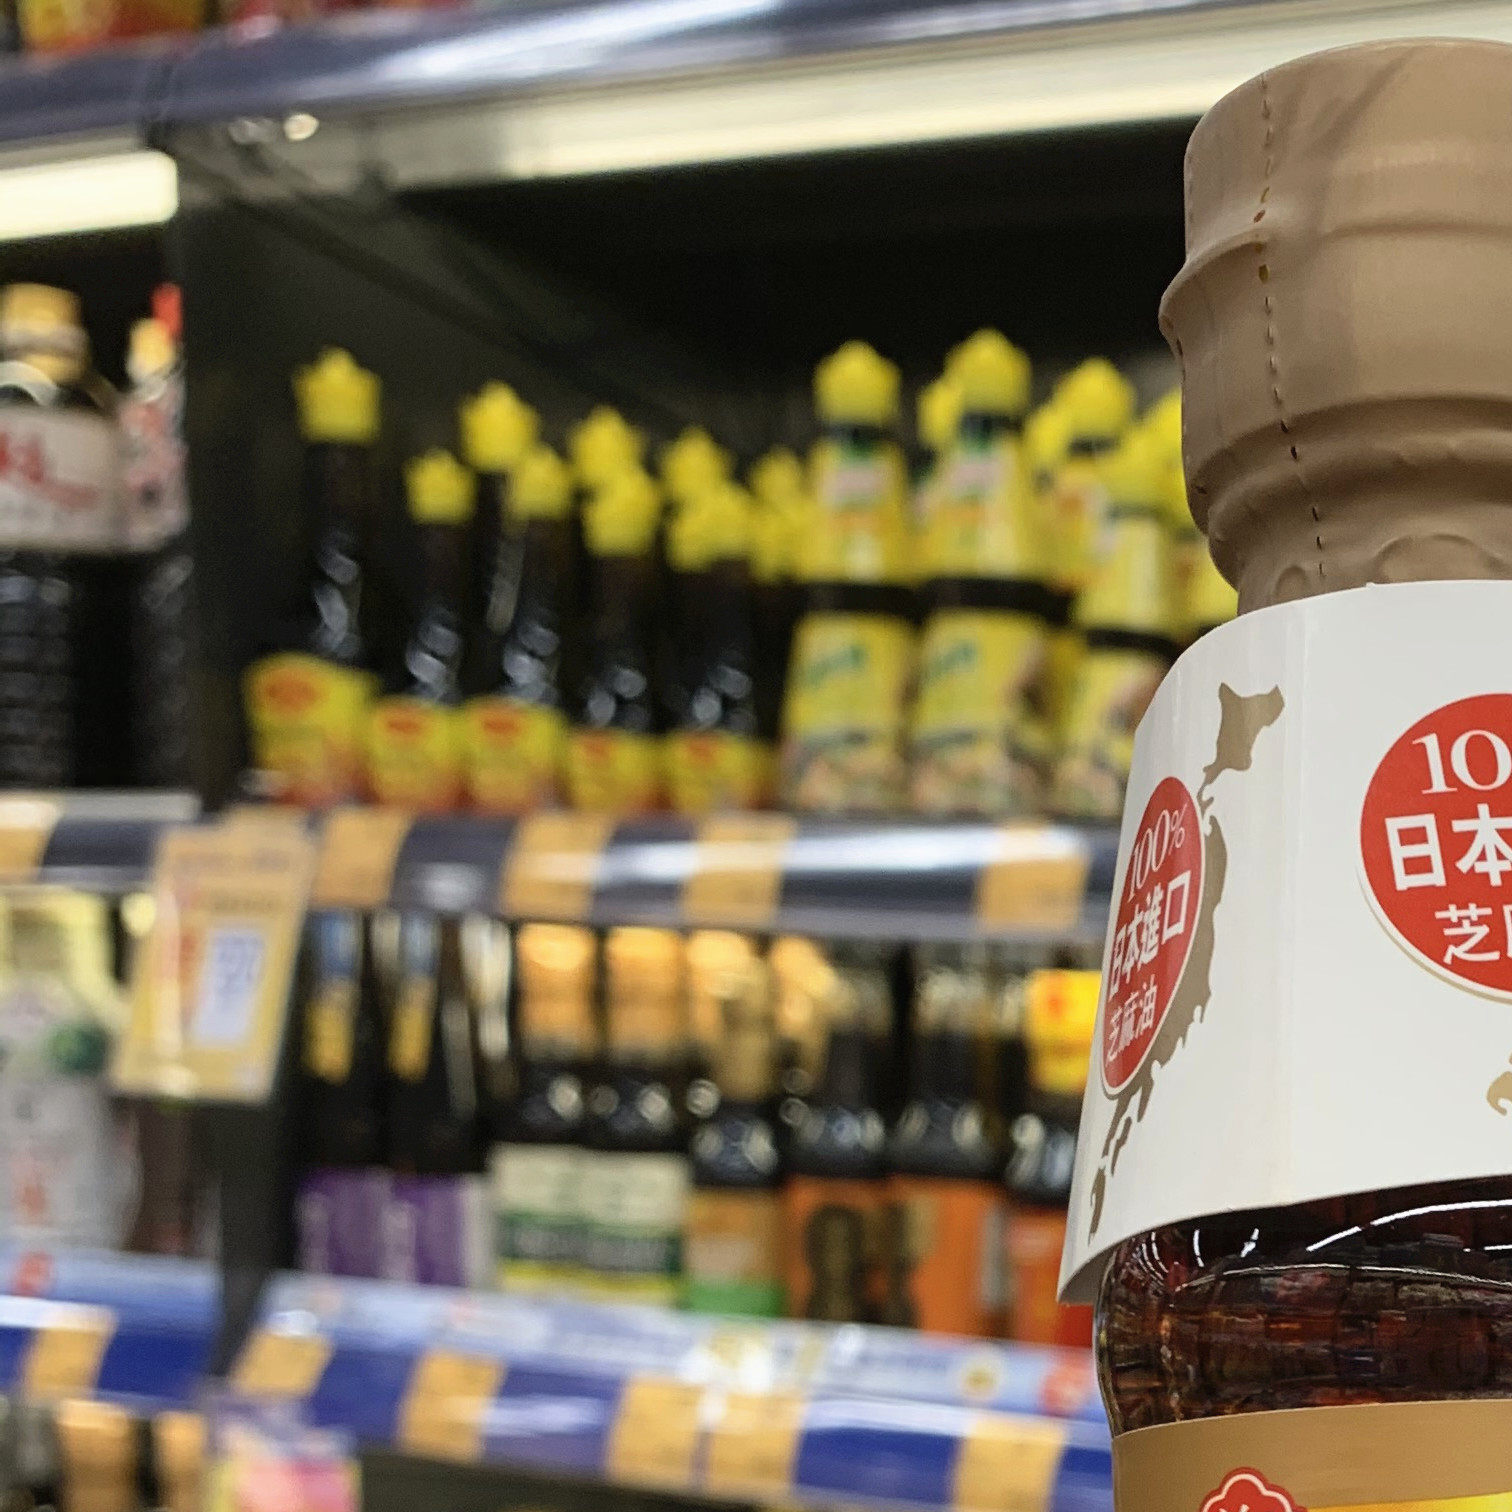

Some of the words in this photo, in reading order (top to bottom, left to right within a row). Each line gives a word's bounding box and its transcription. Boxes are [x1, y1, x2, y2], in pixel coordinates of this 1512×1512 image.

[1127, 804, 1188, 903] 100%
[1109, 870, 1191, 1002] 日本進口
[1106, 974, 1158, 1067] 芝麻油
